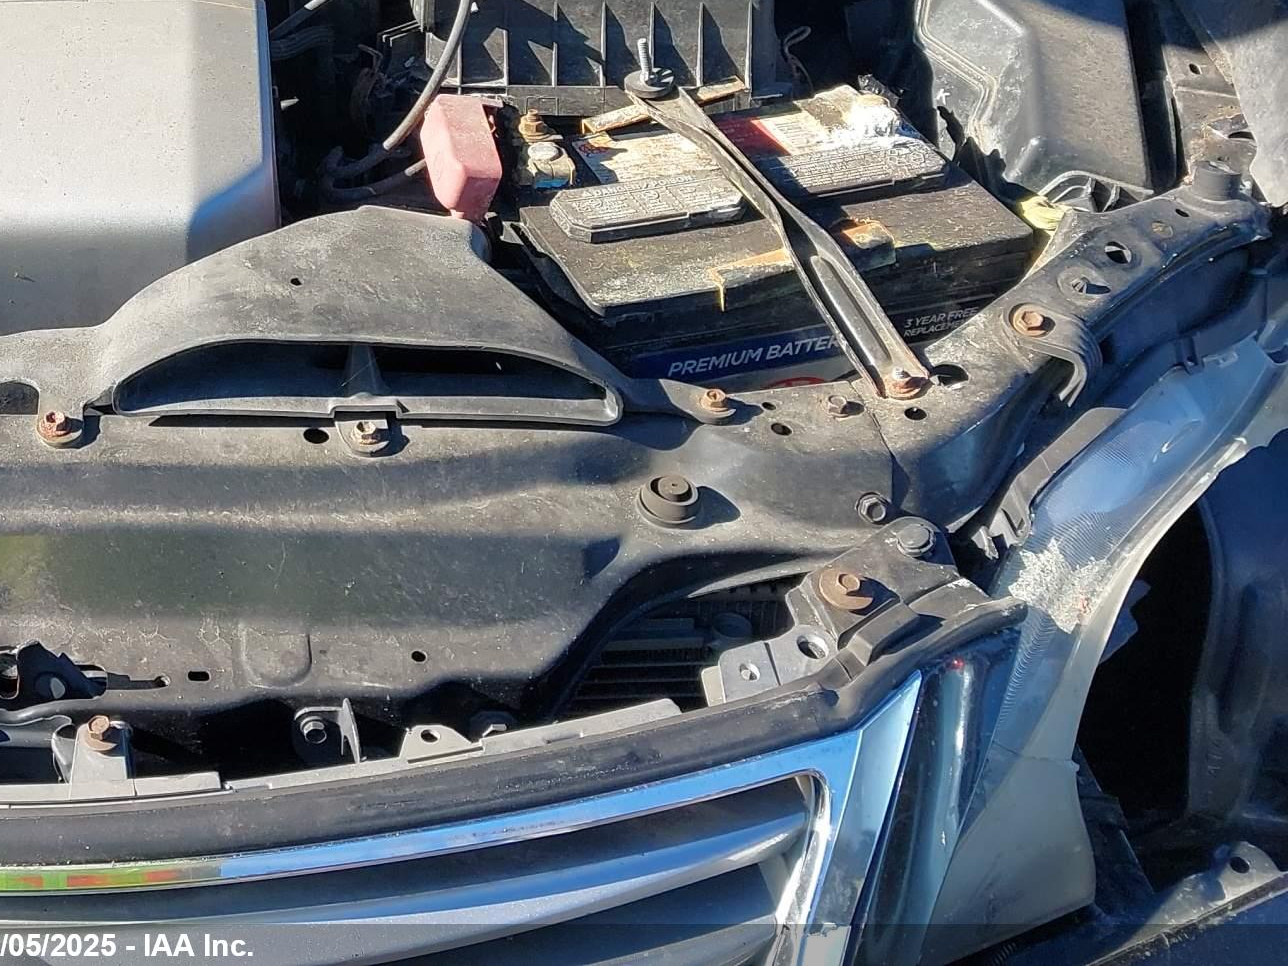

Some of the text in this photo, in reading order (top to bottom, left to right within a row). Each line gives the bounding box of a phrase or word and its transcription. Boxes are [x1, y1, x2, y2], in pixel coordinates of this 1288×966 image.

[903, 306, 980, 329] 3 YEAR FREE
[667, 335, 840, 379] PREMIUM BATTER
